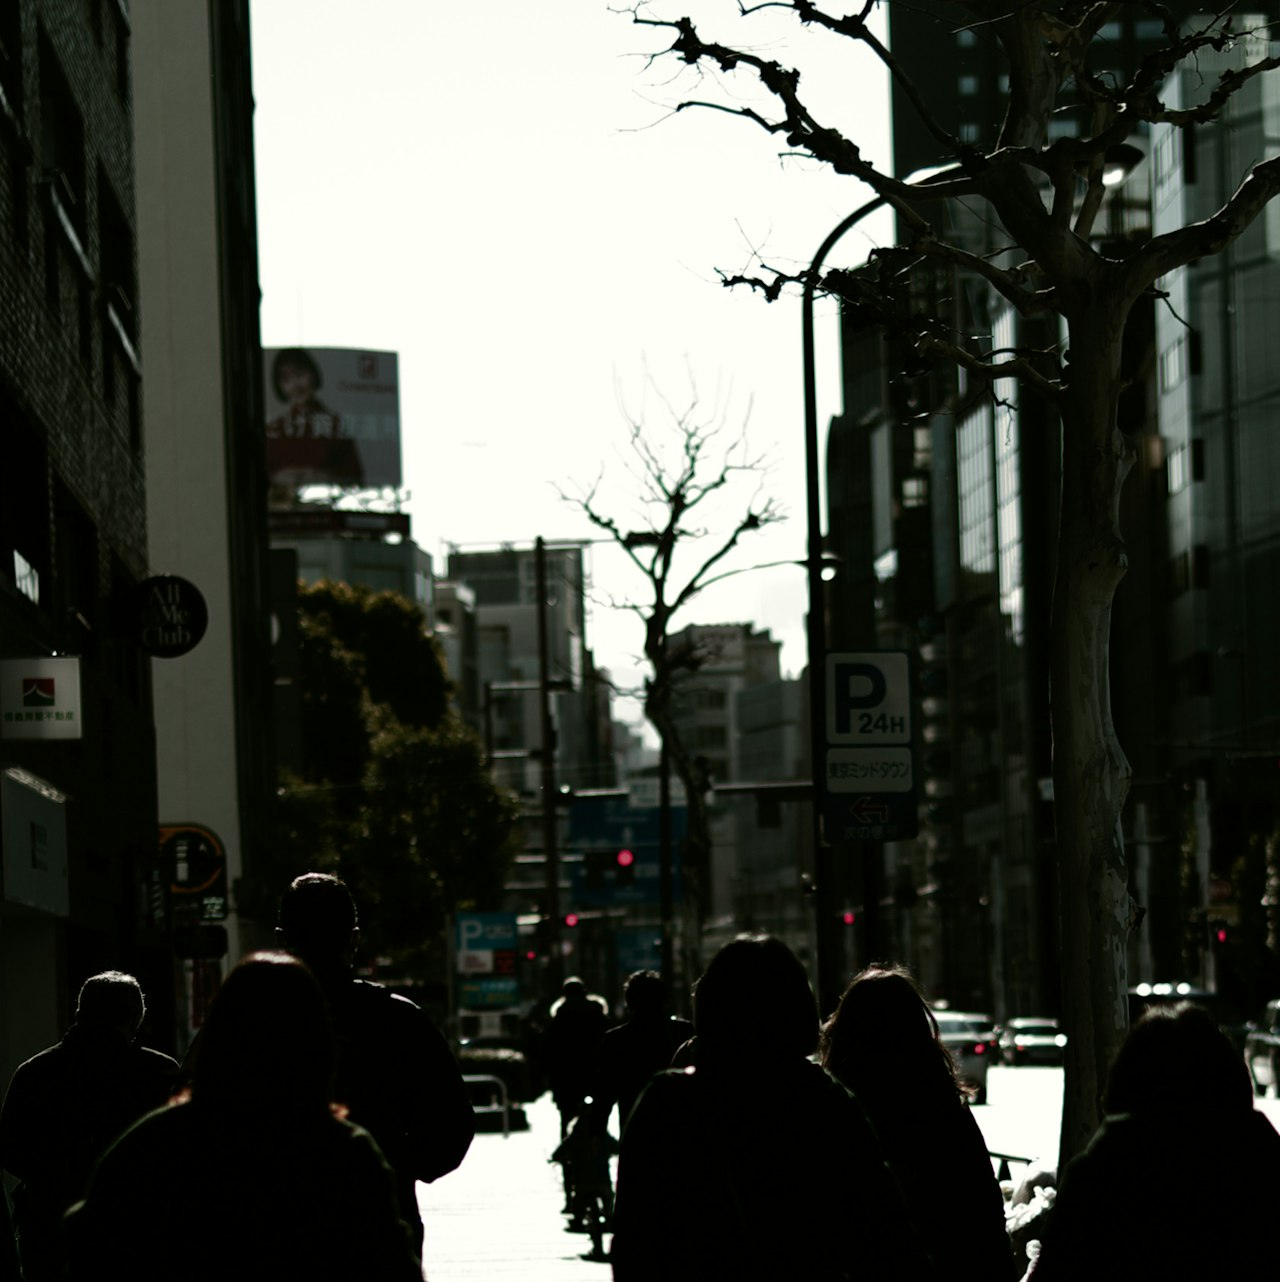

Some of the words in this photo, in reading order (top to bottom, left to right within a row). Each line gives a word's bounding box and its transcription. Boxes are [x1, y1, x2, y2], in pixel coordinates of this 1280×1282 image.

[148, 583, 180, 606] All
[142, 625, 192, 647] Club
[835, 663, 887, 734] P
[858, 713, 904, 734] 24H
[829, 762, 909, 780] 東京ミッドタウン
